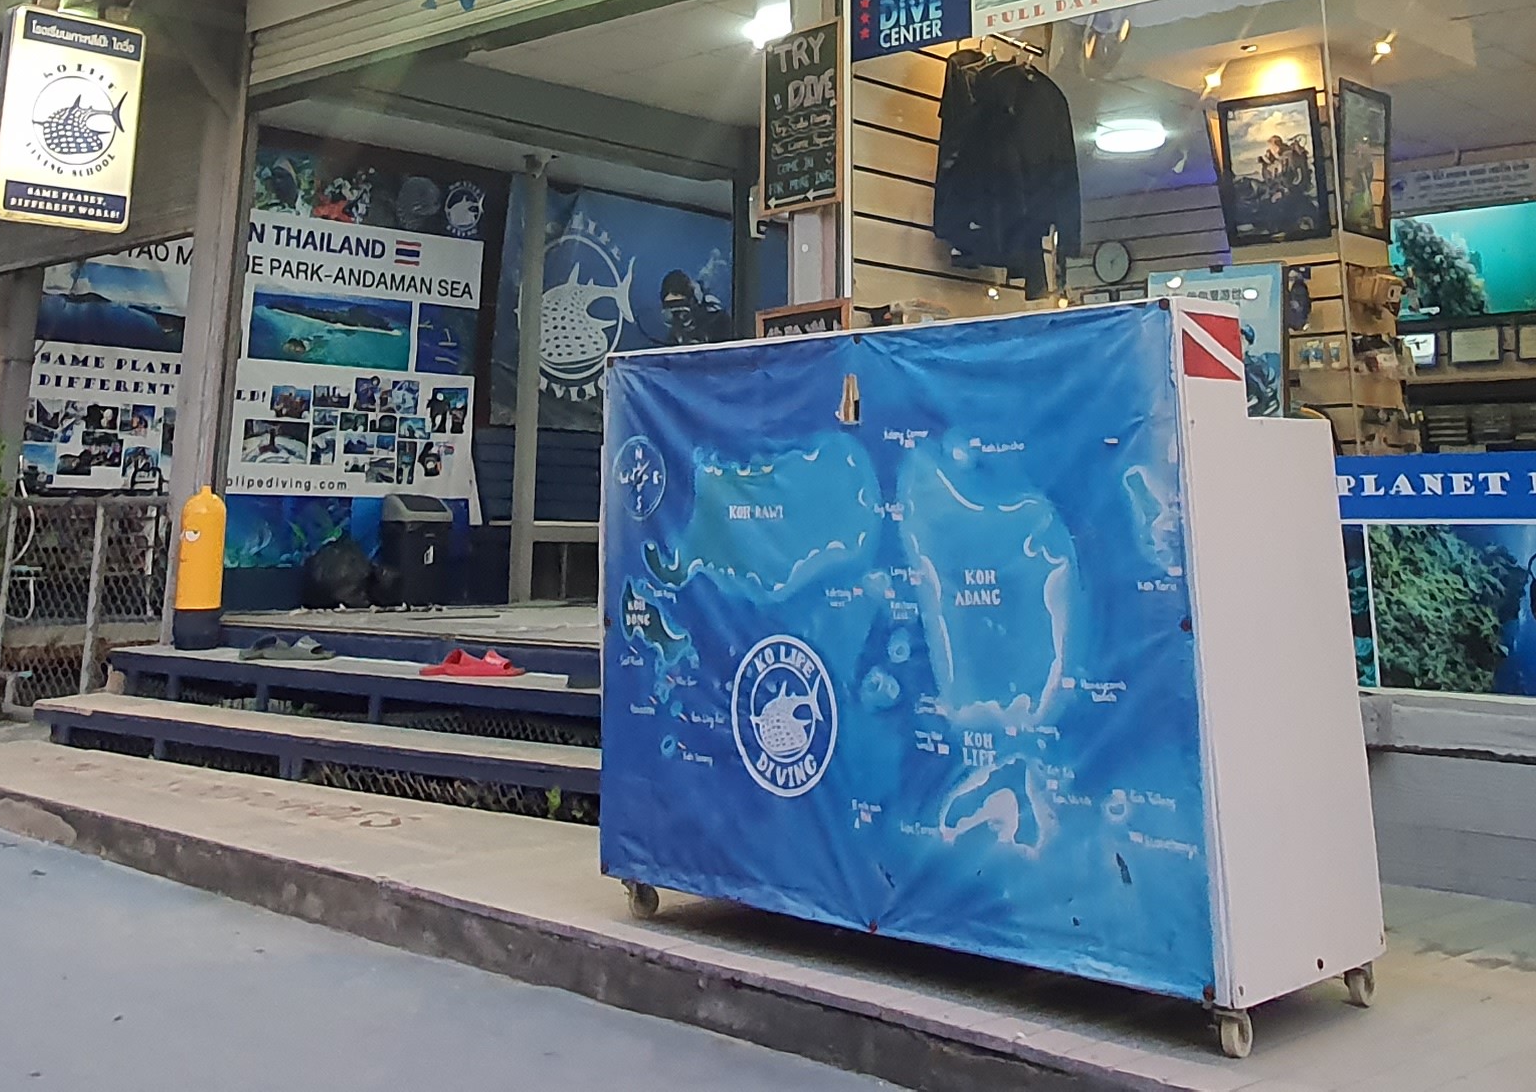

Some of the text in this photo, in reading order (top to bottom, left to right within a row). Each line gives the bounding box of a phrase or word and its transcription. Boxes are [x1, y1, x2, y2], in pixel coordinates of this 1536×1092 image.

[986, 4, 1045, 28] FULL
[880, 19, 942, 48] CENTER
[774, 32, 825, 73] TRY
[788, 67, 835, 112] DIVE
[27, 186, 59, 200] SAME
[10, 198, 76, 213] DIFFERENT
[273, 227, 386, 260] THAILAND
[437, 278, 473, 300] SEA
[40, 352, 105, 370] SAME
[38, 373, 175, 396] DIFFERENT
[226, 476, 347, 491] olipediving.com
[1336, 471, 1510, 497] PLANET
[965, 569, 996, 585] KOH
[955, 589, 1001, 606] ADANG
[754, 645, 816, 678] KO LIPE
[964, 731, 993, 747] KOH
[962, 747, 997, 767] LIPE
[756, 752, 817, 787] DIVING
